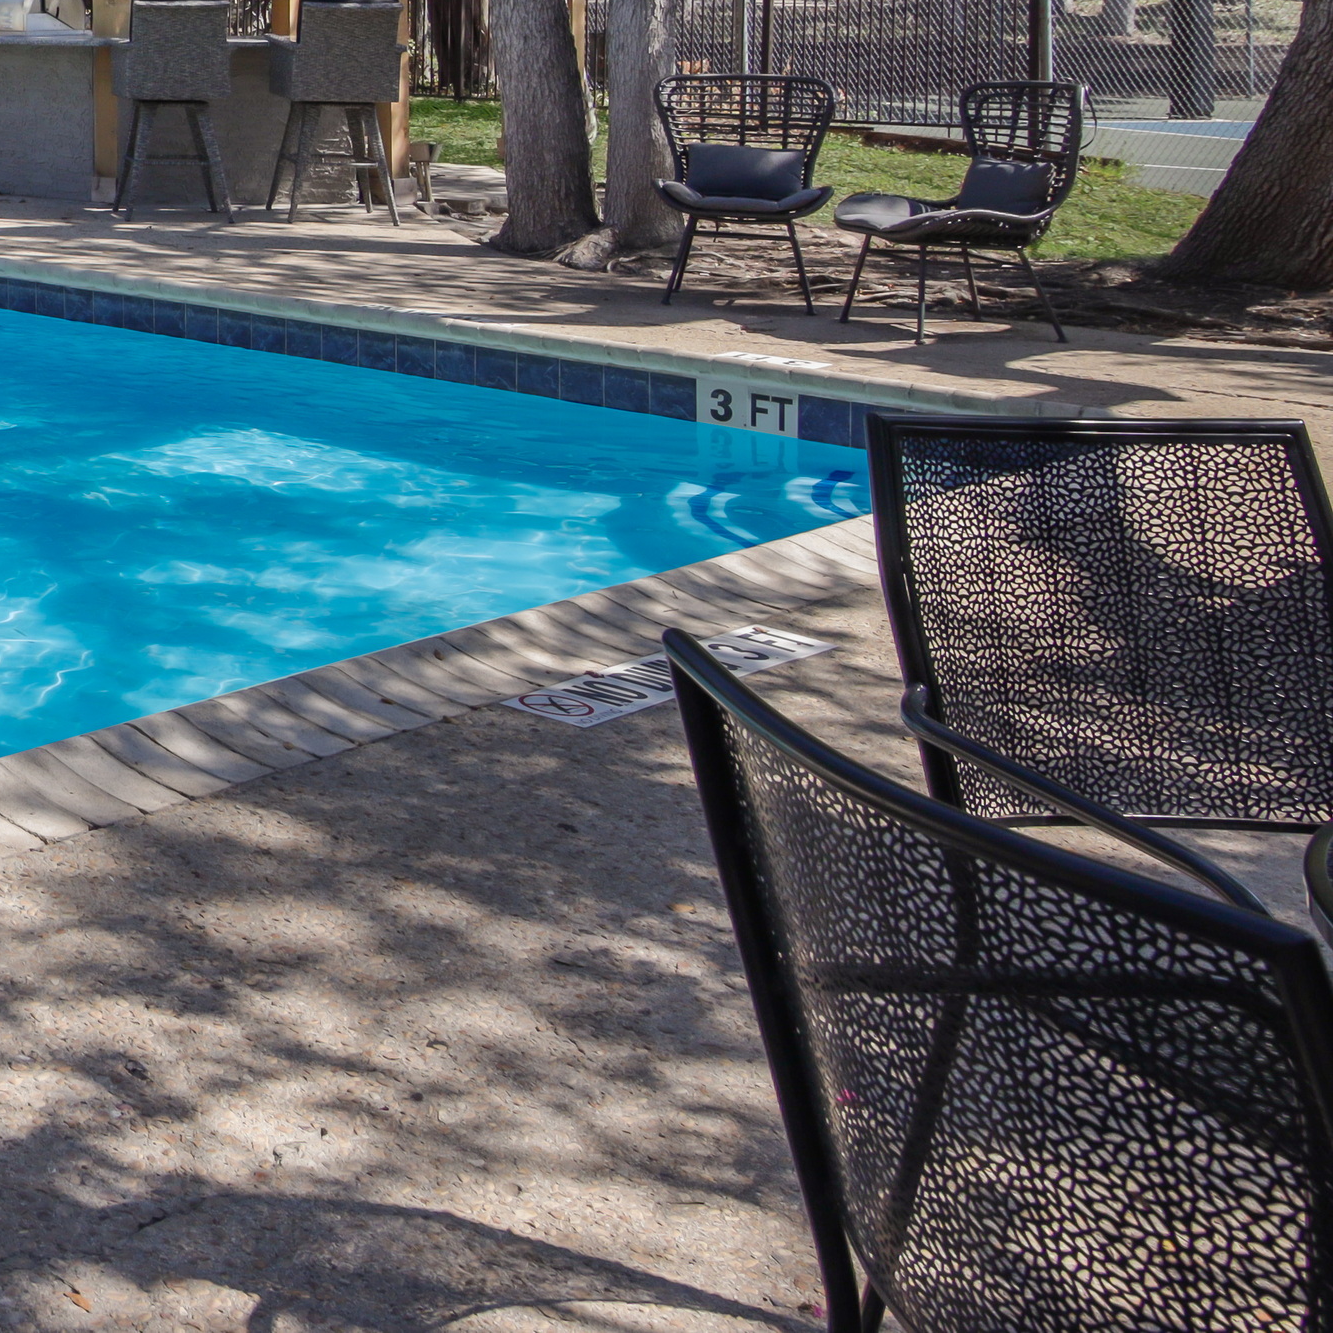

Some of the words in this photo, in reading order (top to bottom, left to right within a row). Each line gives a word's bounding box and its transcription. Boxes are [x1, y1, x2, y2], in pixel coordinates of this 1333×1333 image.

[710, 389, 733, 422] 3
[751, 393, 793, 431] FT
[707, 643, 770, 661] 3
[736, 627, 815, 653] FT
[561, 680, 648, 707] NO
